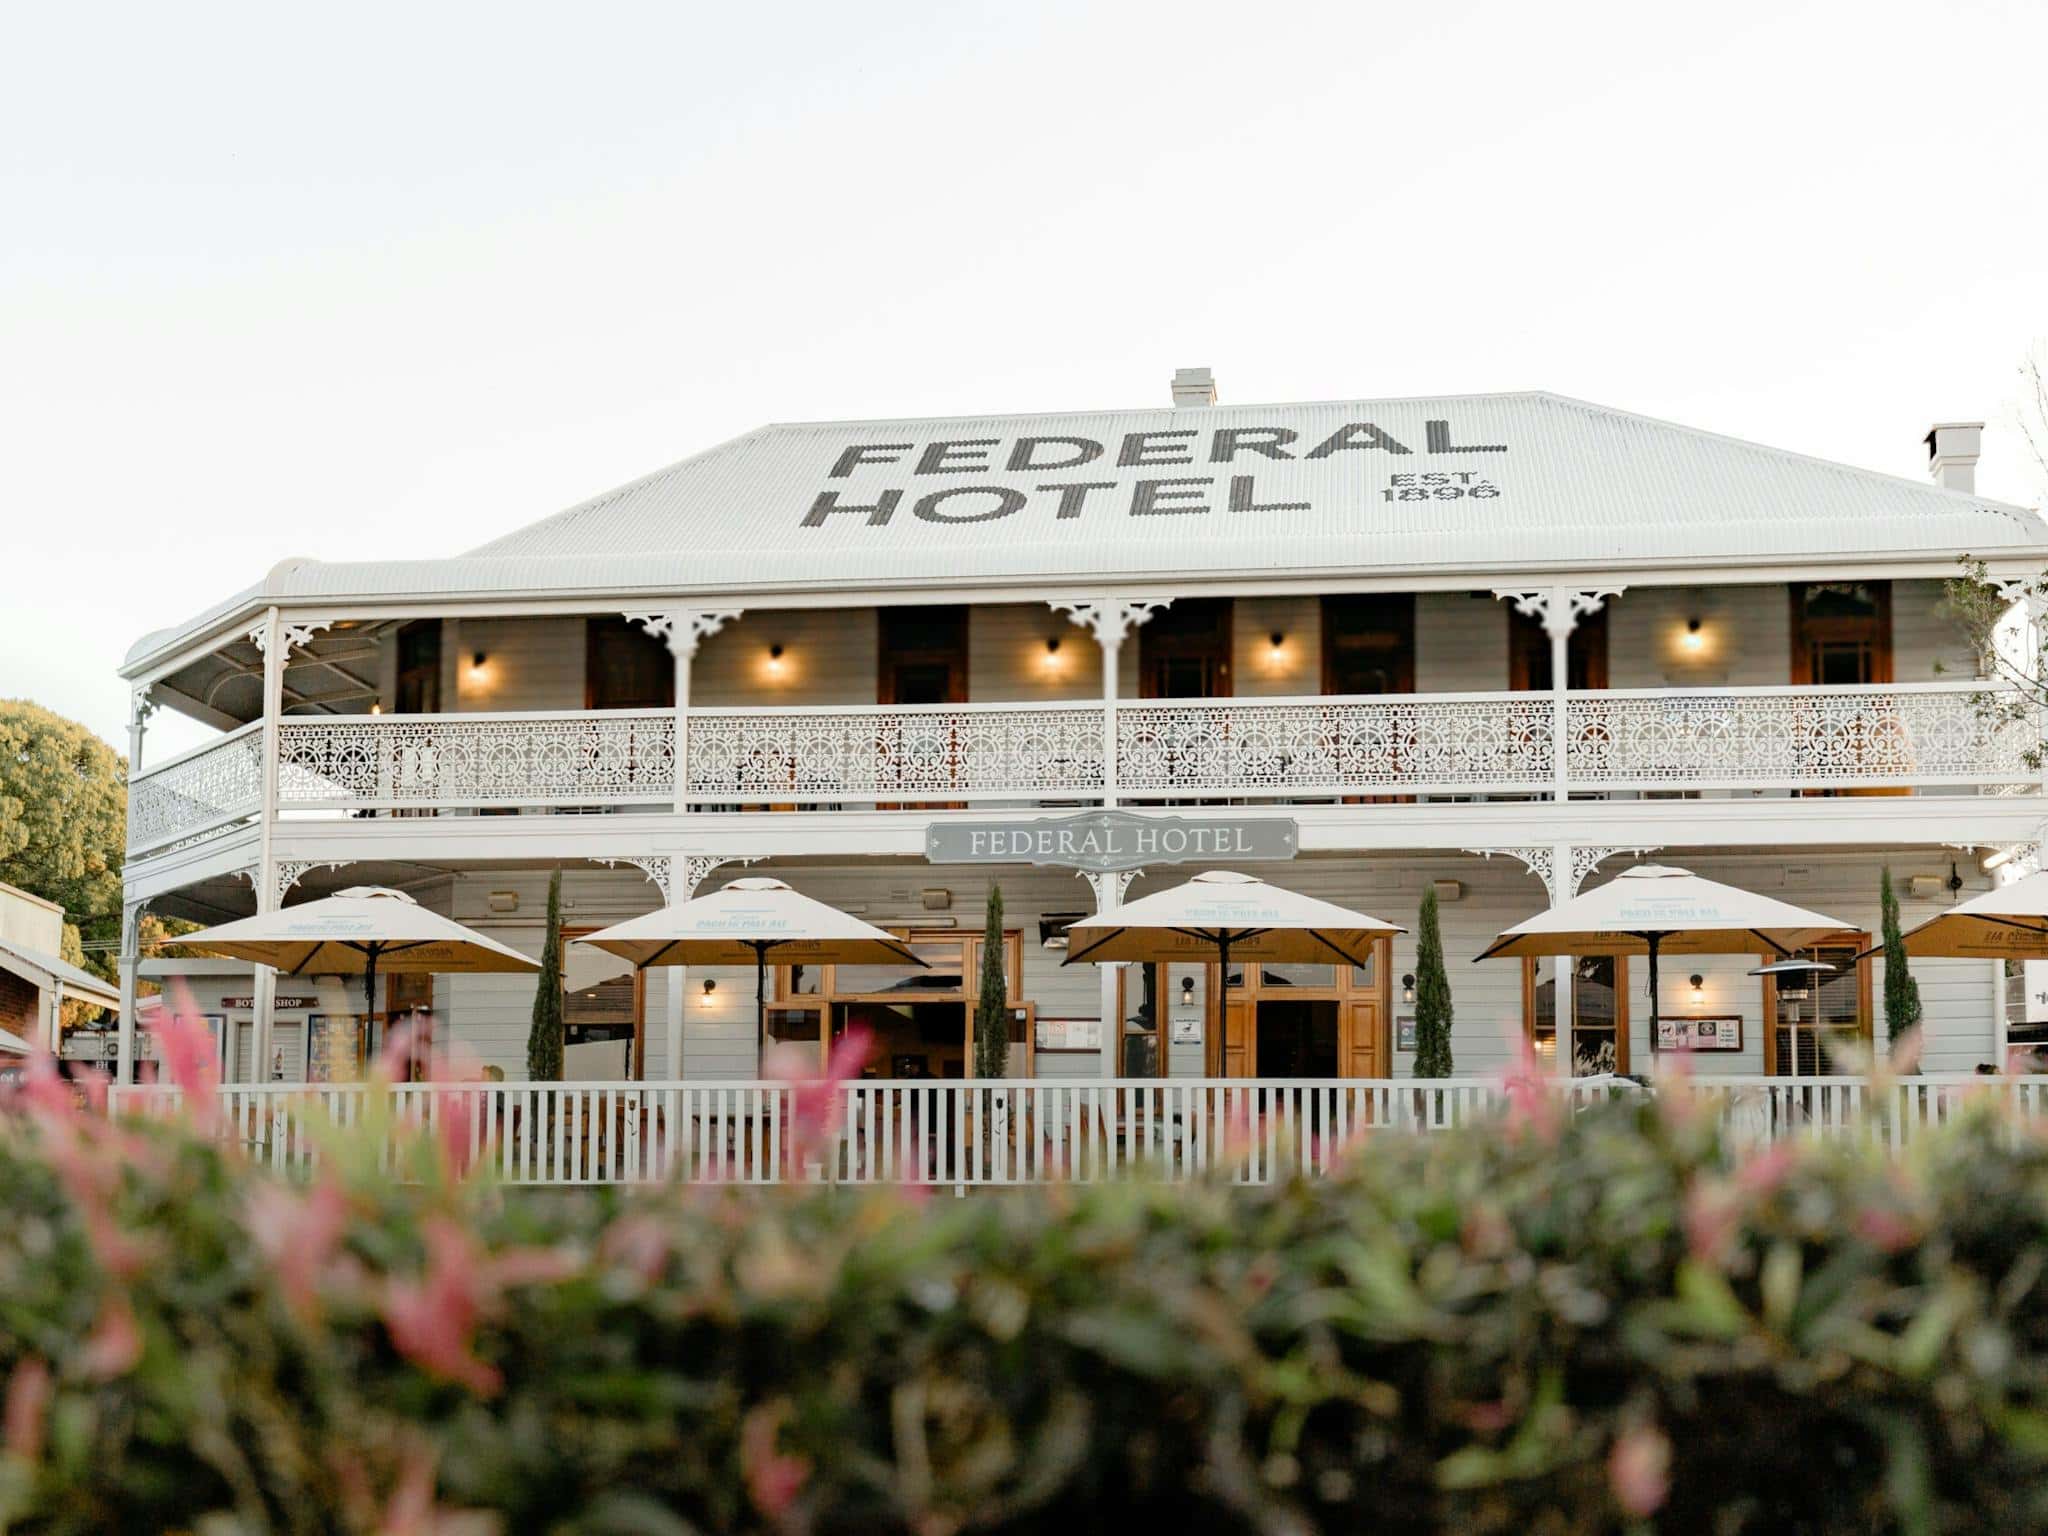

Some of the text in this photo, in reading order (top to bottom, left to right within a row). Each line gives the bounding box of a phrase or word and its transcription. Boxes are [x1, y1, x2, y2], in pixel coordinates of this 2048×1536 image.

[828, 420, 1508, 478] FEDERAL
[800, 475, 1312, 528] HOTEL
[1380, 486, 1500, 502] 1896
[970, 827, 1253, 855] FEDERAL HOTEL
[275, 998, 303, 1008] SHOP
